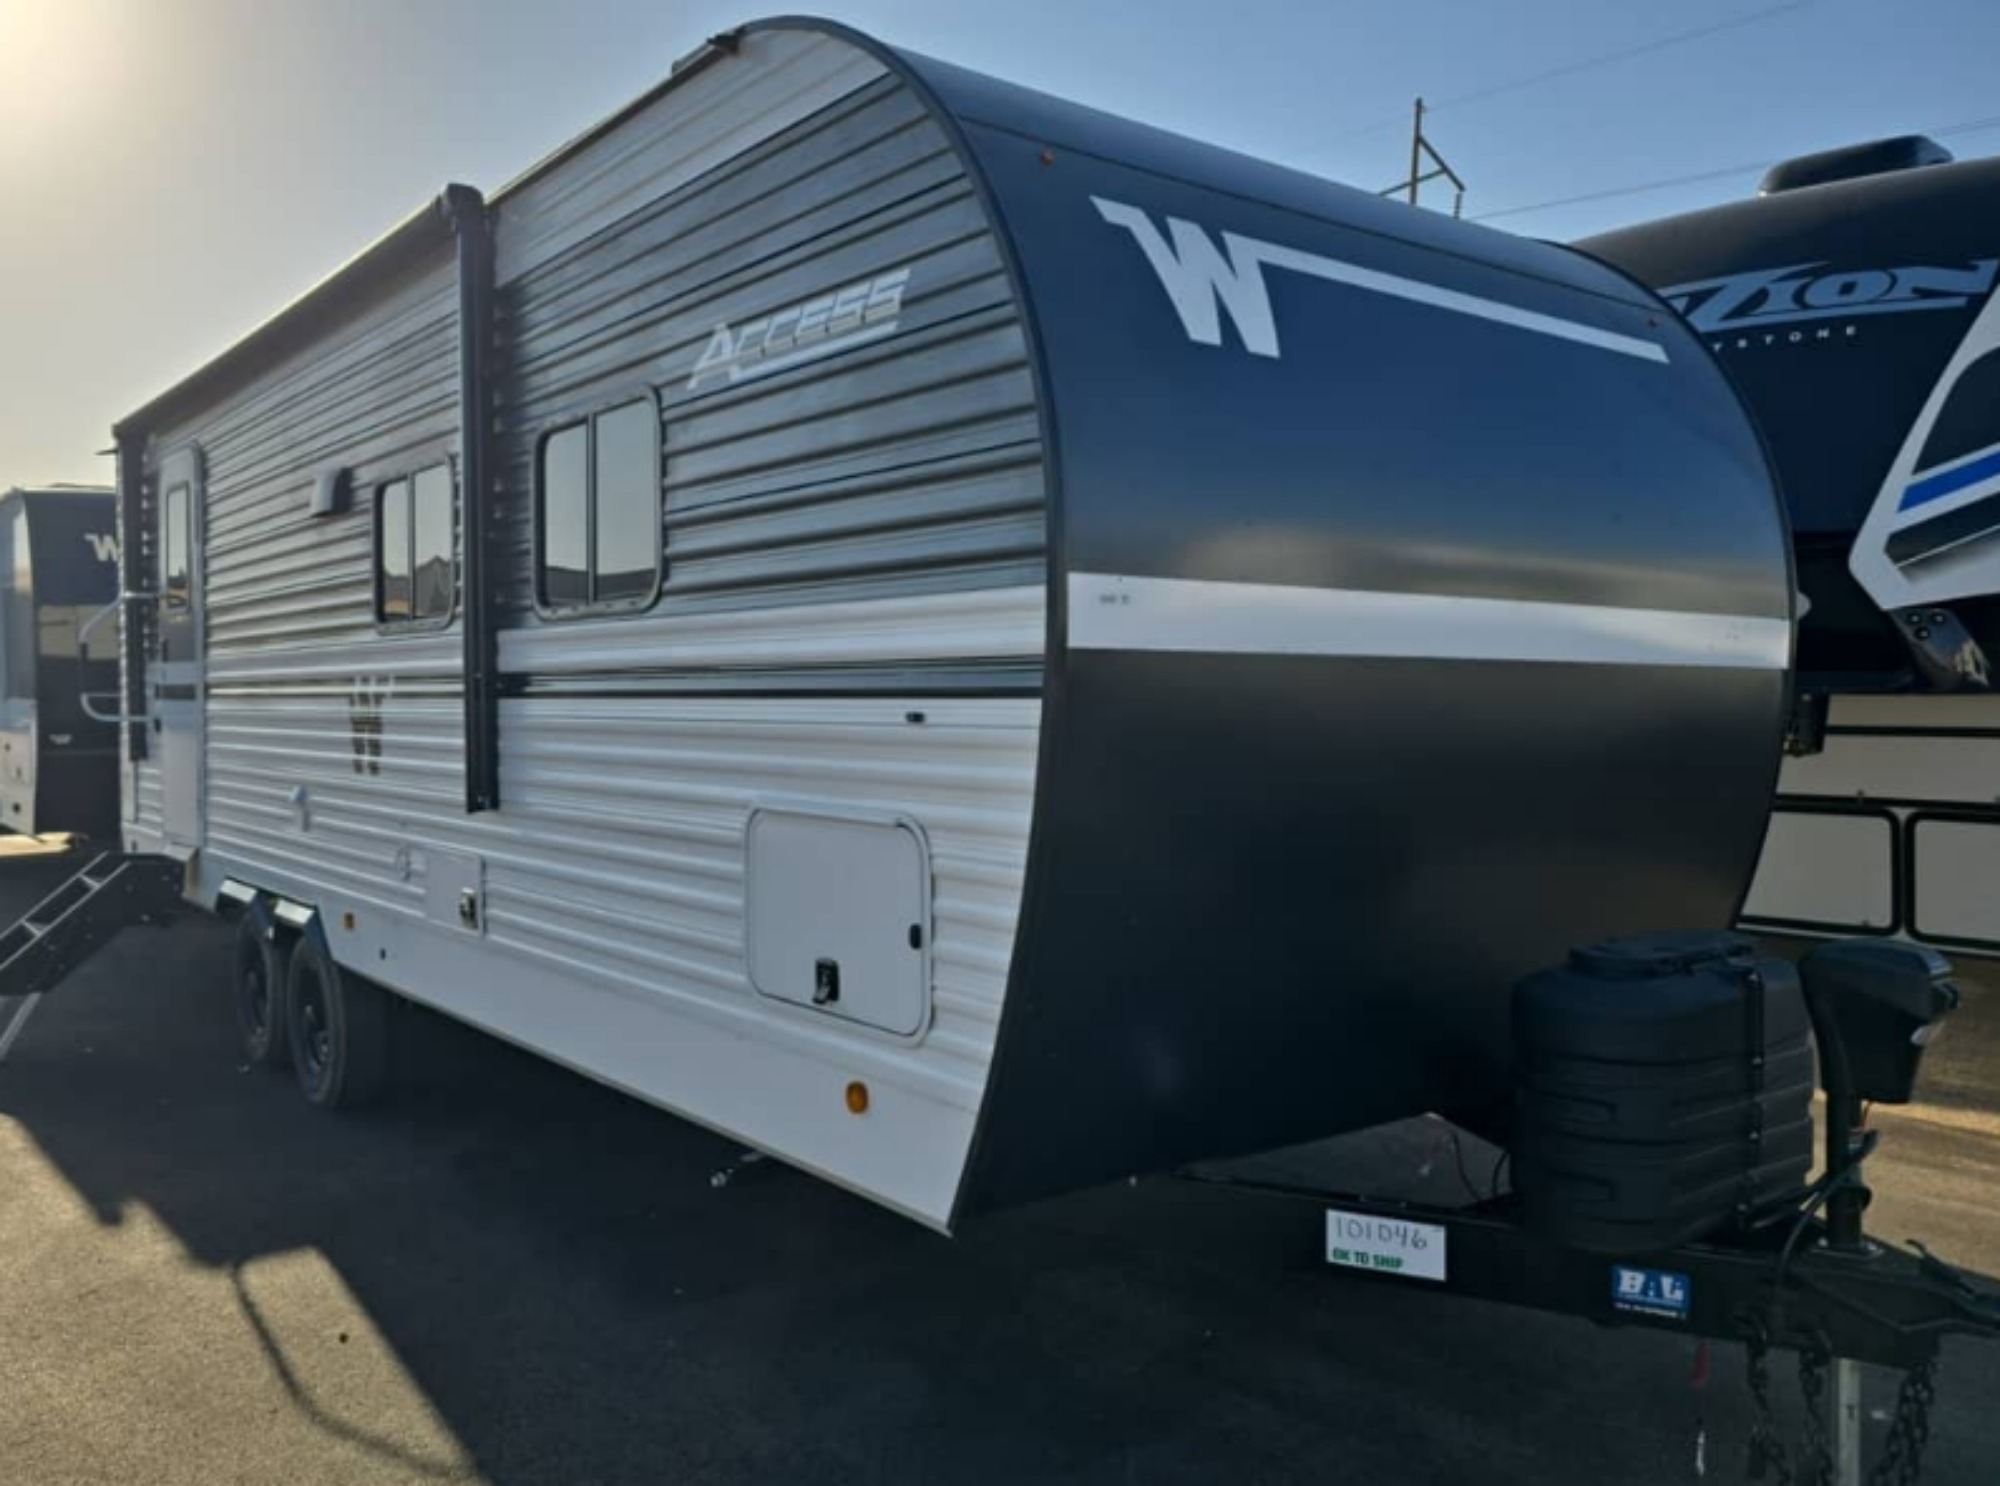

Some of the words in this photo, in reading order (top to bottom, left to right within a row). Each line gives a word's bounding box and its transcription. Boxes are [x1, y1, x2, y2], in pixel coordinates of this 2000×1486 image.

[1655, 260, 1999, 333] ZION
[1711, 325, 1856, 353] YSTONE
[1336, 1216, 1428, 1250] 101046
[1354, 1251, 1370, 1264] TO
[1373, 1254, 1403, 1269] SHIP
